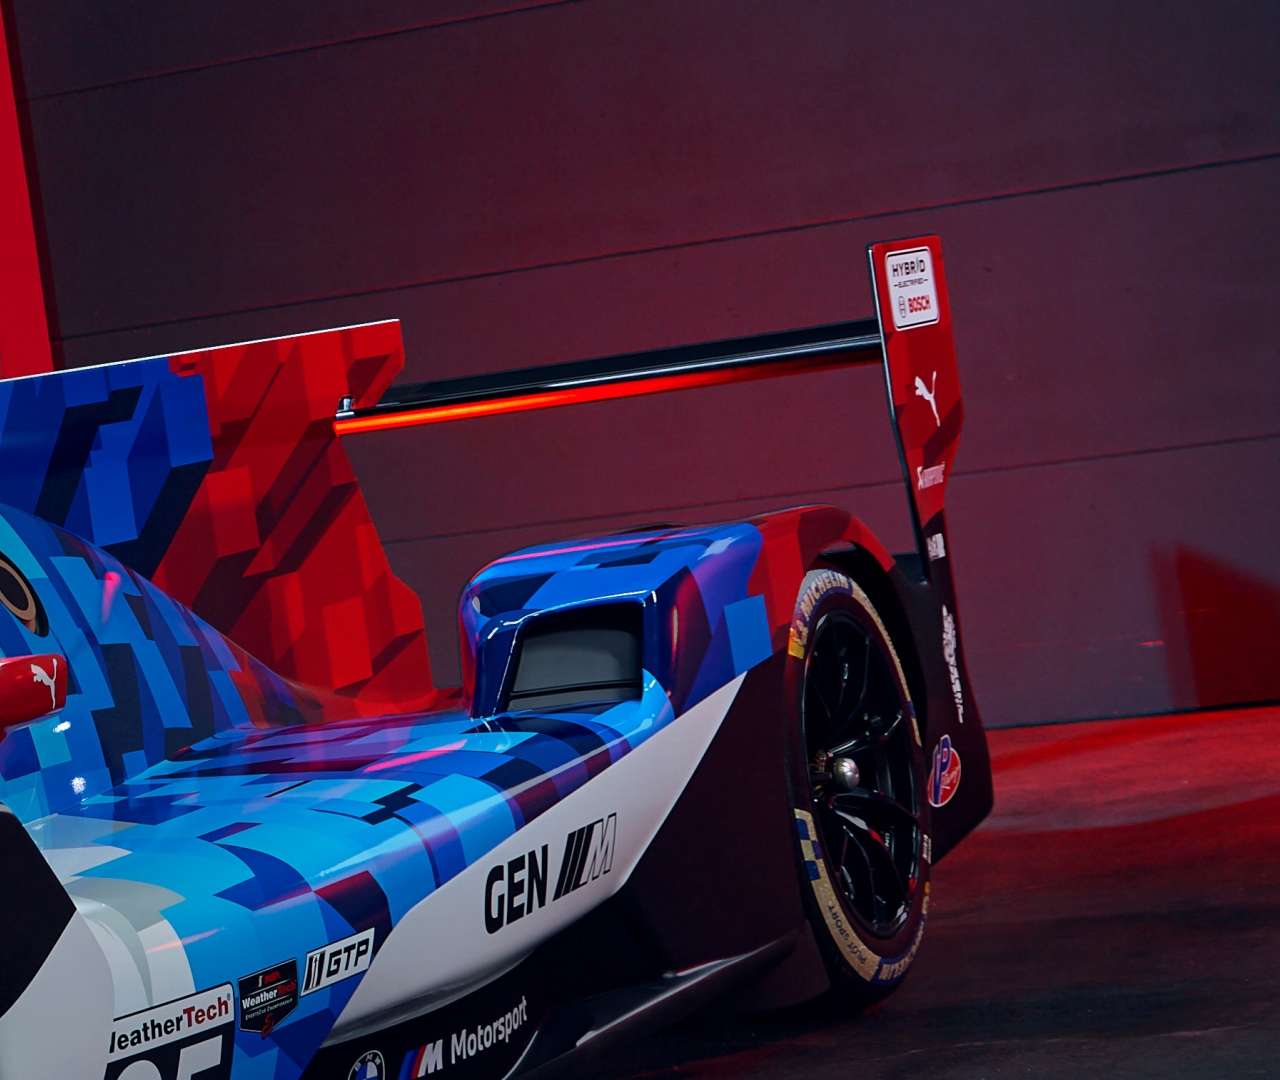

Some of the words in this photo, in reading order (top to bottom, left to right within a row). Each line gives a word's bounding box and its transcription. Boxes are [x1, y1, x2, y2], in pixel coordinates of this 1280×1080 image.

[892, 257, 926, 277] HYBRID
[908, 295, 931, 313] BOSCH
[801, 570, 850, 622] MICHELIN
[484, 843, 549, 935] GEN
[828, 905, 851, 941] SPORT
[326, 938, 370, 978] GTP
[242, 980, 297, 1009] WeatherTech
[109, 997, 230, 1054] eatherTech
[450, 995, 527, 1065] Motorsport
